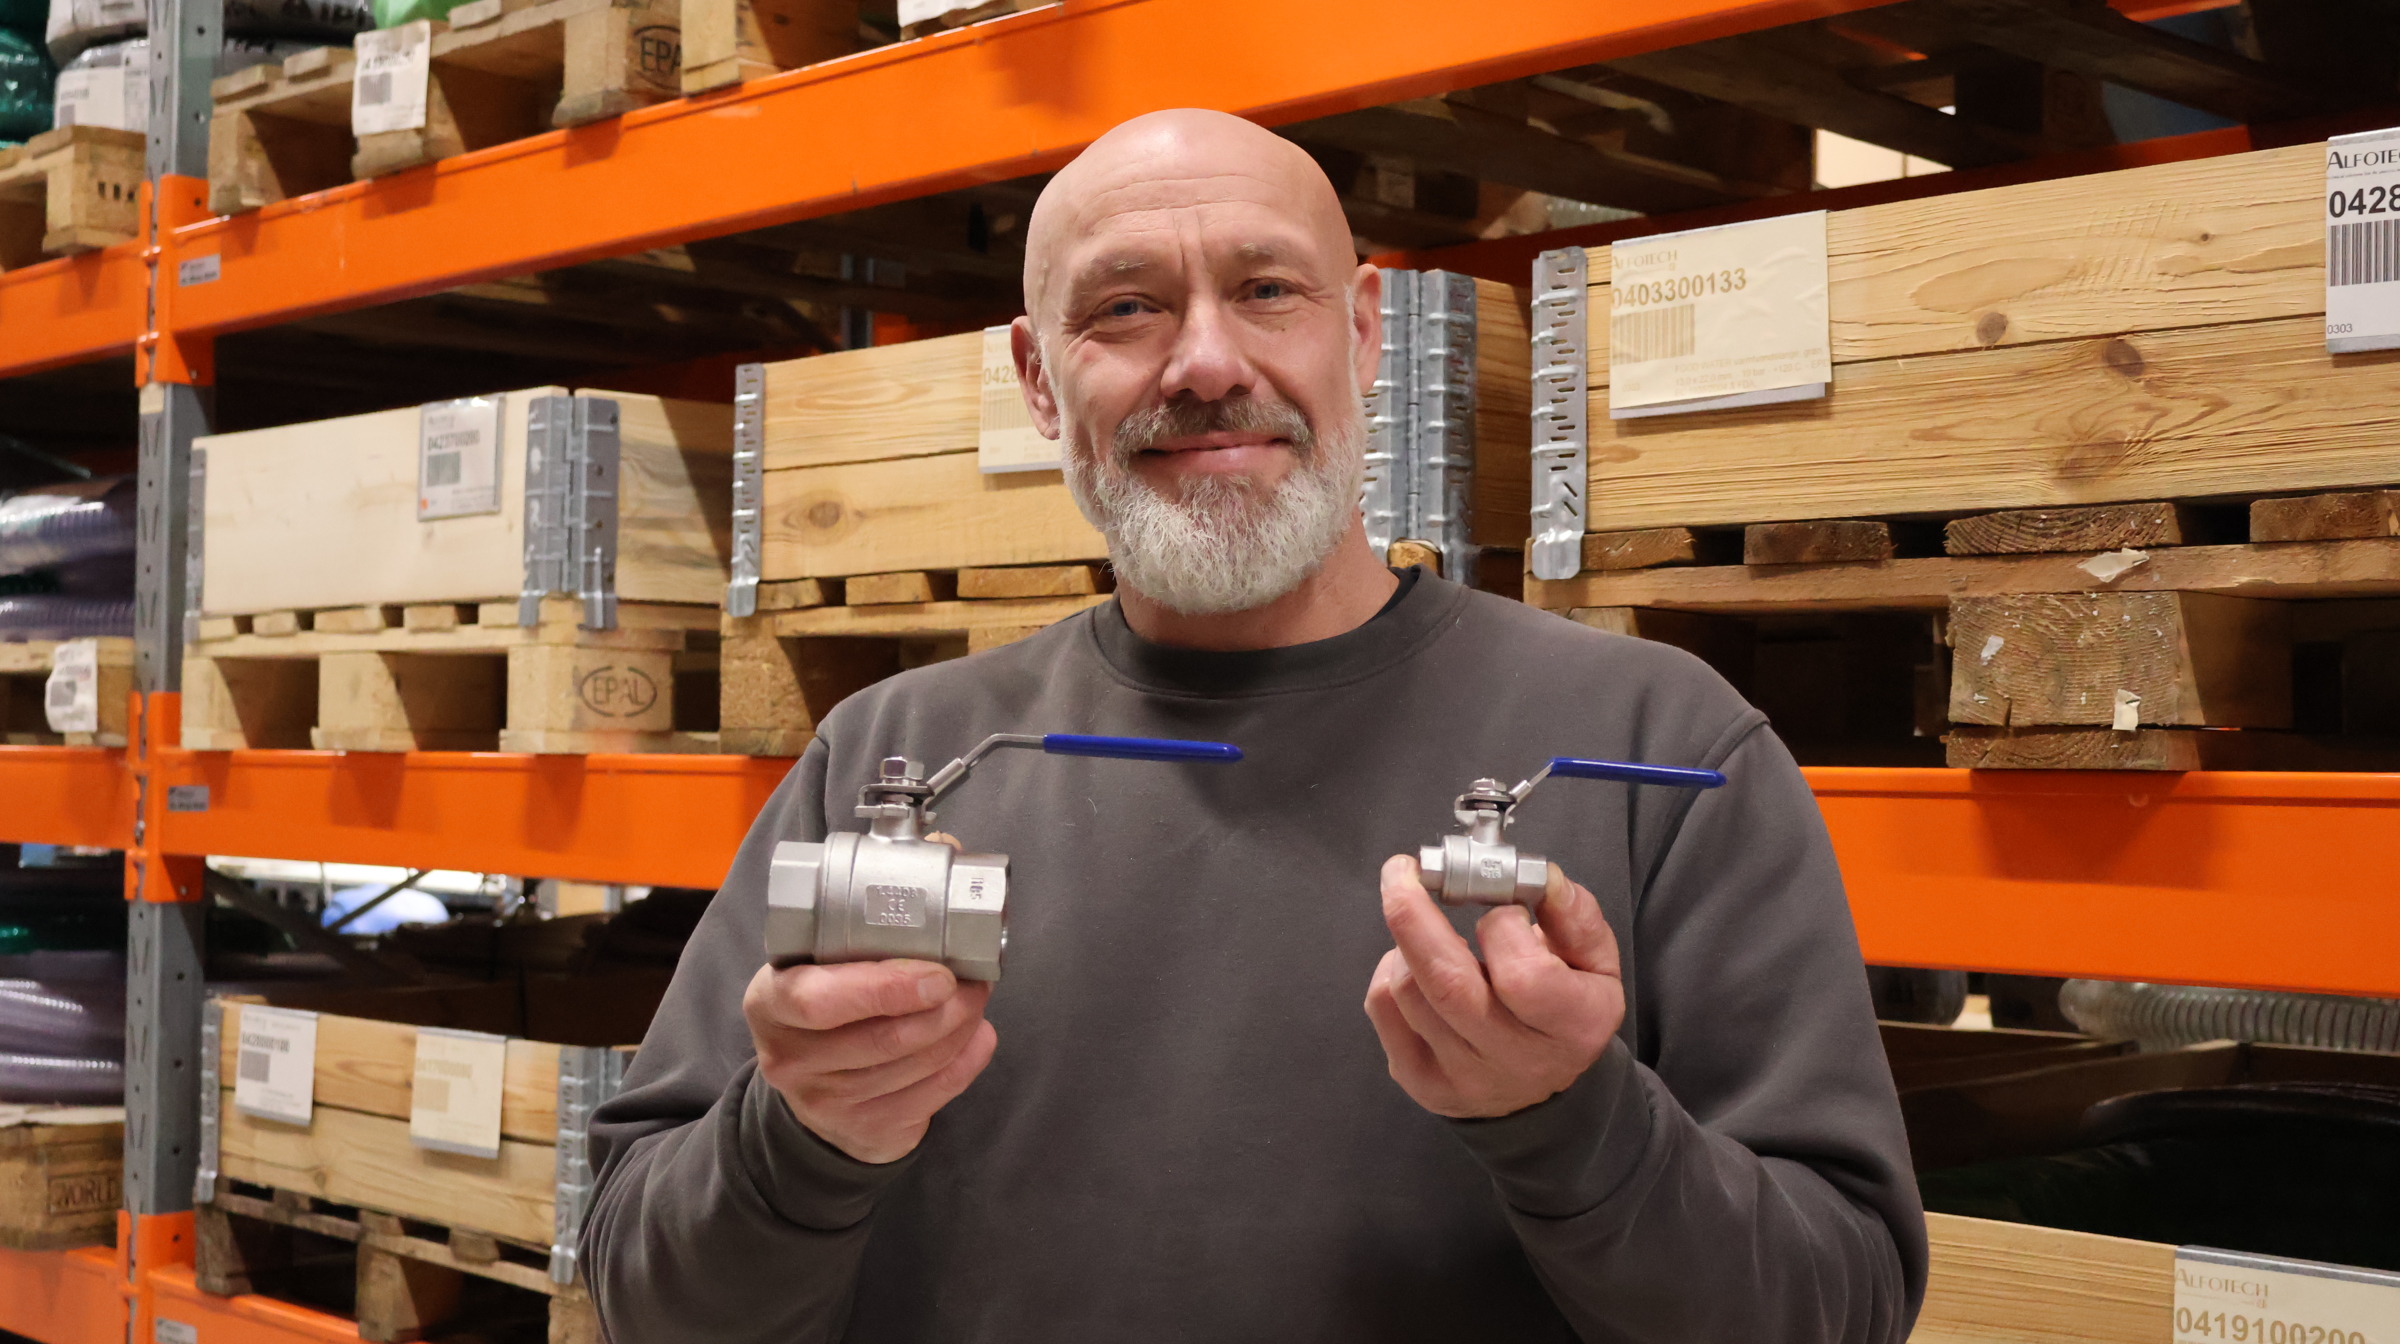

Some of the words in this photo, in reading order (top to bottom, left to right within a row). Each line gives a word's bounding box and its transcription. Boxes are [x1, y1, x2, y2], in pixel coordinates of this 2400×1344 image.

[2327, 149, 2400, 170] ALFOTE
[2329, 184, 2400, 218] 0428
[1612, 267, 1747, 310] 0403300133
[2327, 323, 2353, 334] 0303
[592, 676, 645, 706] EPAL
[2174, 1268, 2268, 1297] ALFOTECH
